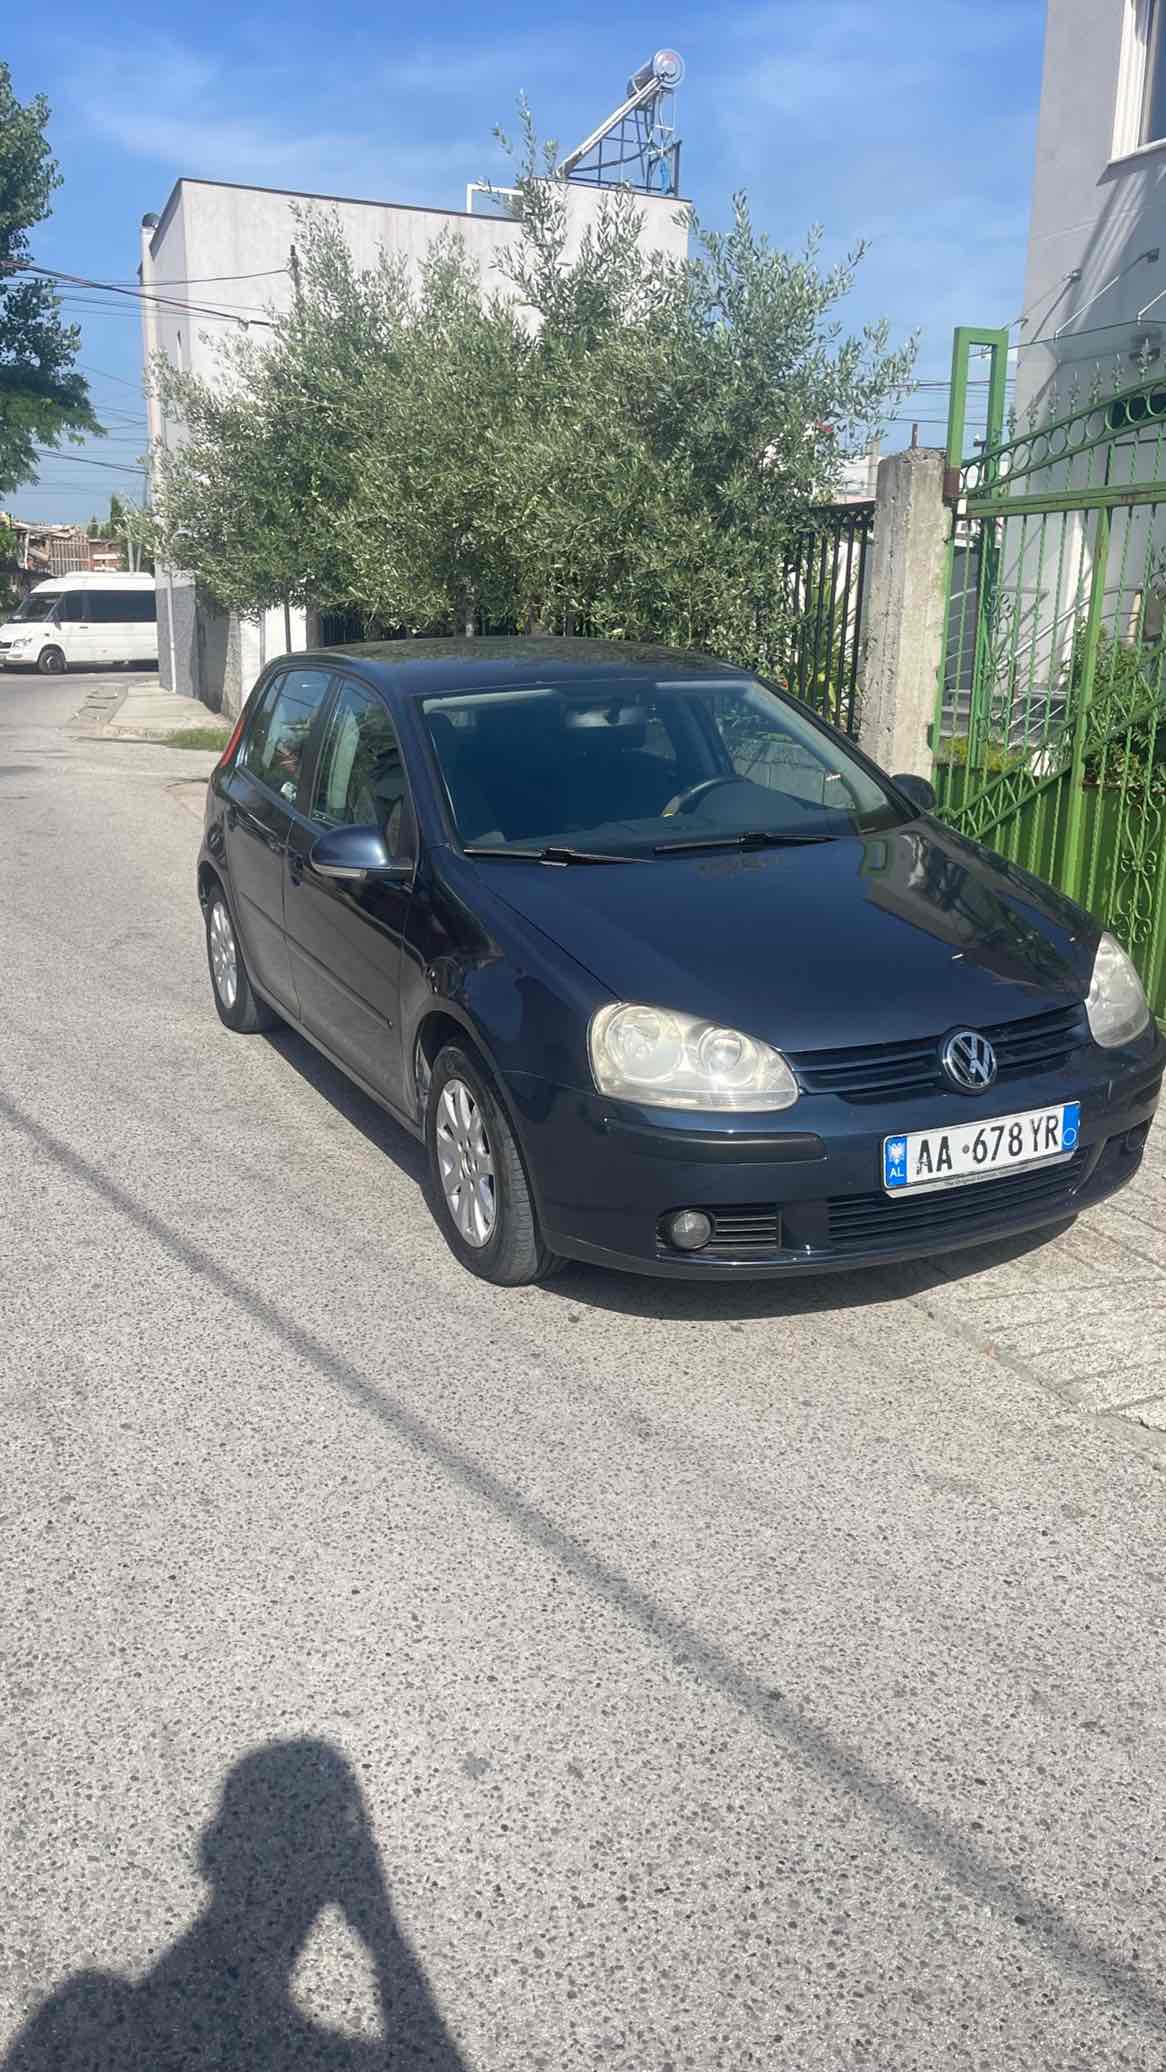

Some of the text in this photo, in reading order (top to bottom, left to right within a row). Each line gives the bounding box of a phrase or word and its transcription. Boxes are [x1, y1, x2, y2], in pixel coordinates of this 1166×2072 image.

[916, 1116, 1060, 1176] AA 678 YR
[889, 1167, 905, 1178] AL
